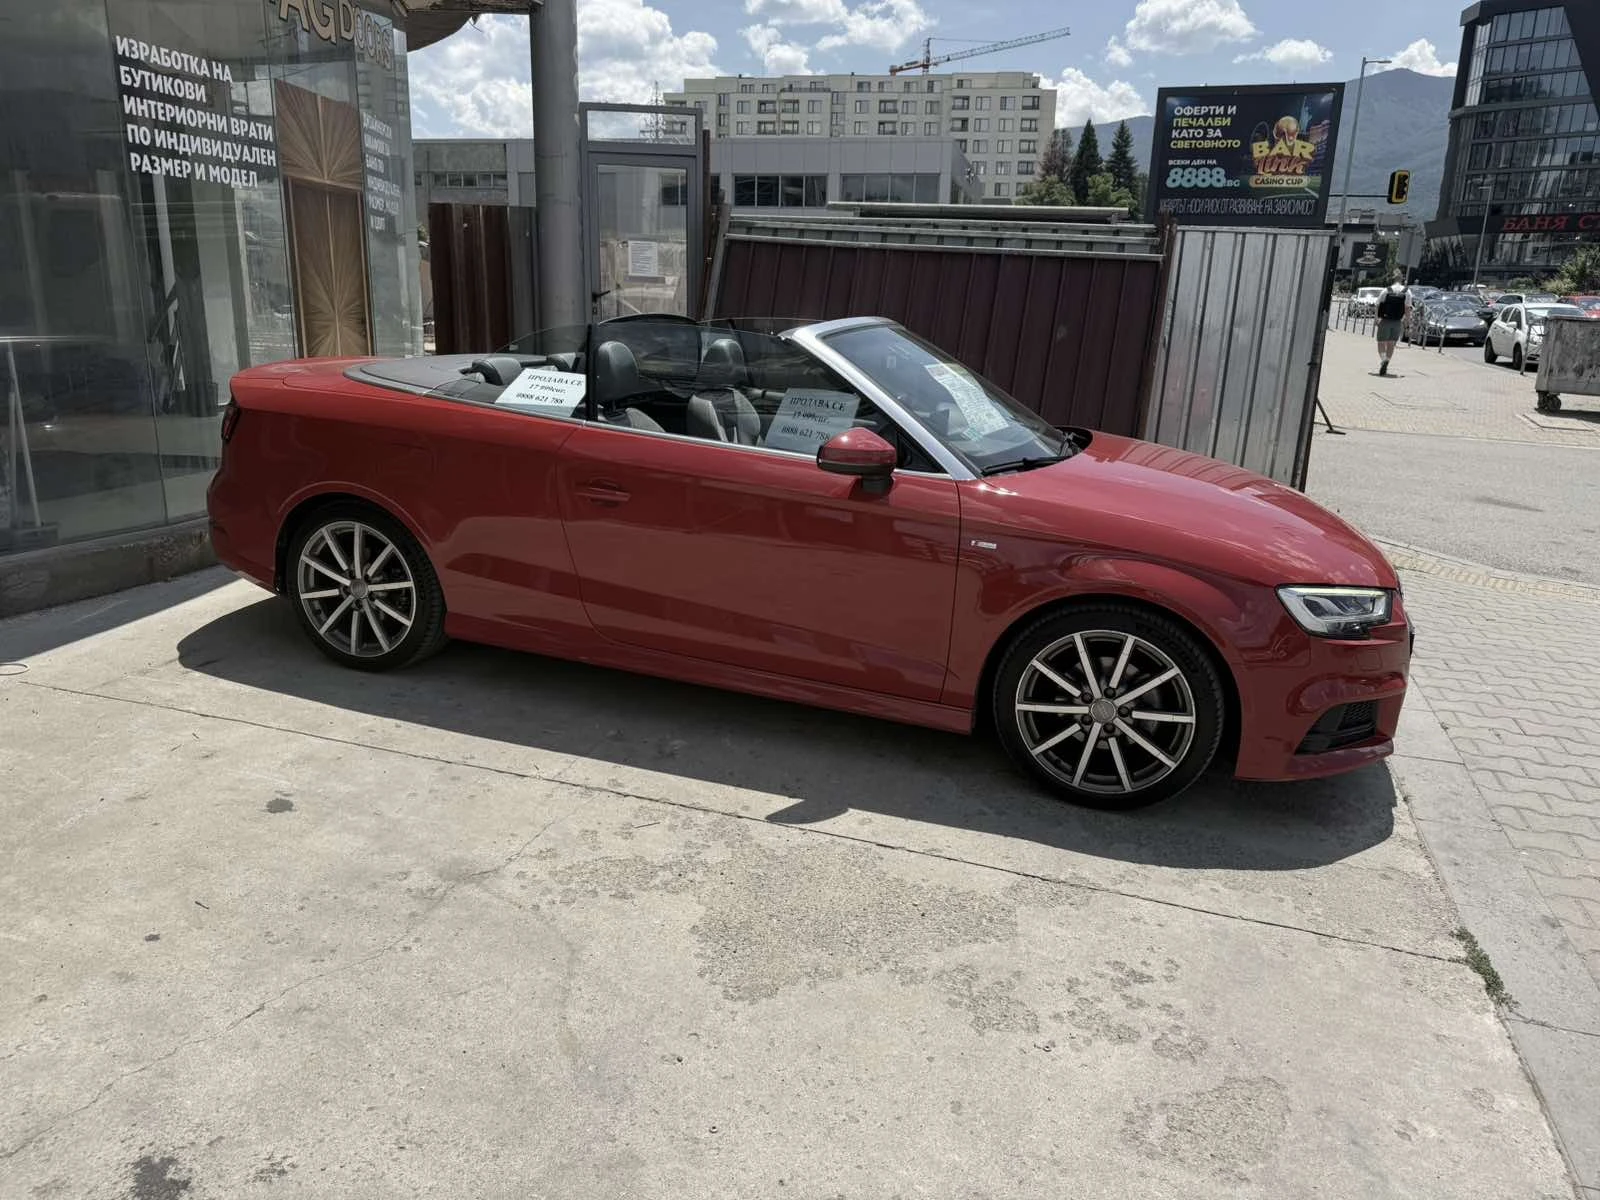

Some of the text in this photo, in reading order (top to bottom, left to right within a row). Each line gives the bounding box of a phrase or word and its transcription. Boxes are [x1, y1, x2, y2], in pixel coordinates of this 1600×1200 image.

[116, 35, 233, 83] ИЗРАБОТКА НА
[120, 65, 206, 102] БУТИКОВИ
[123, 94, 274, 142] ИНТЕРИОРНИ ВРАТИ
[1174, 105, 1237, 116] ОФЕРТИ И
[1173, 117, 1231, 127] ПЕЧАЛБИ
[1171, 128, 1222, 138] КАТО ЗА
[127, 123, 277, 167] ПО ИНДИВИДУАЛЕН
[1170, 139, 1241, 149] СВЕТОВНОТО
[1252, 138, 1315, 160] BAR
[130, 152, 258, 189] РАЗМЕР И МОДЕЛ
[1255, 177, 1304, 185] CASINO CUP
[1503, 215, 1569, 231] БАНЯ
